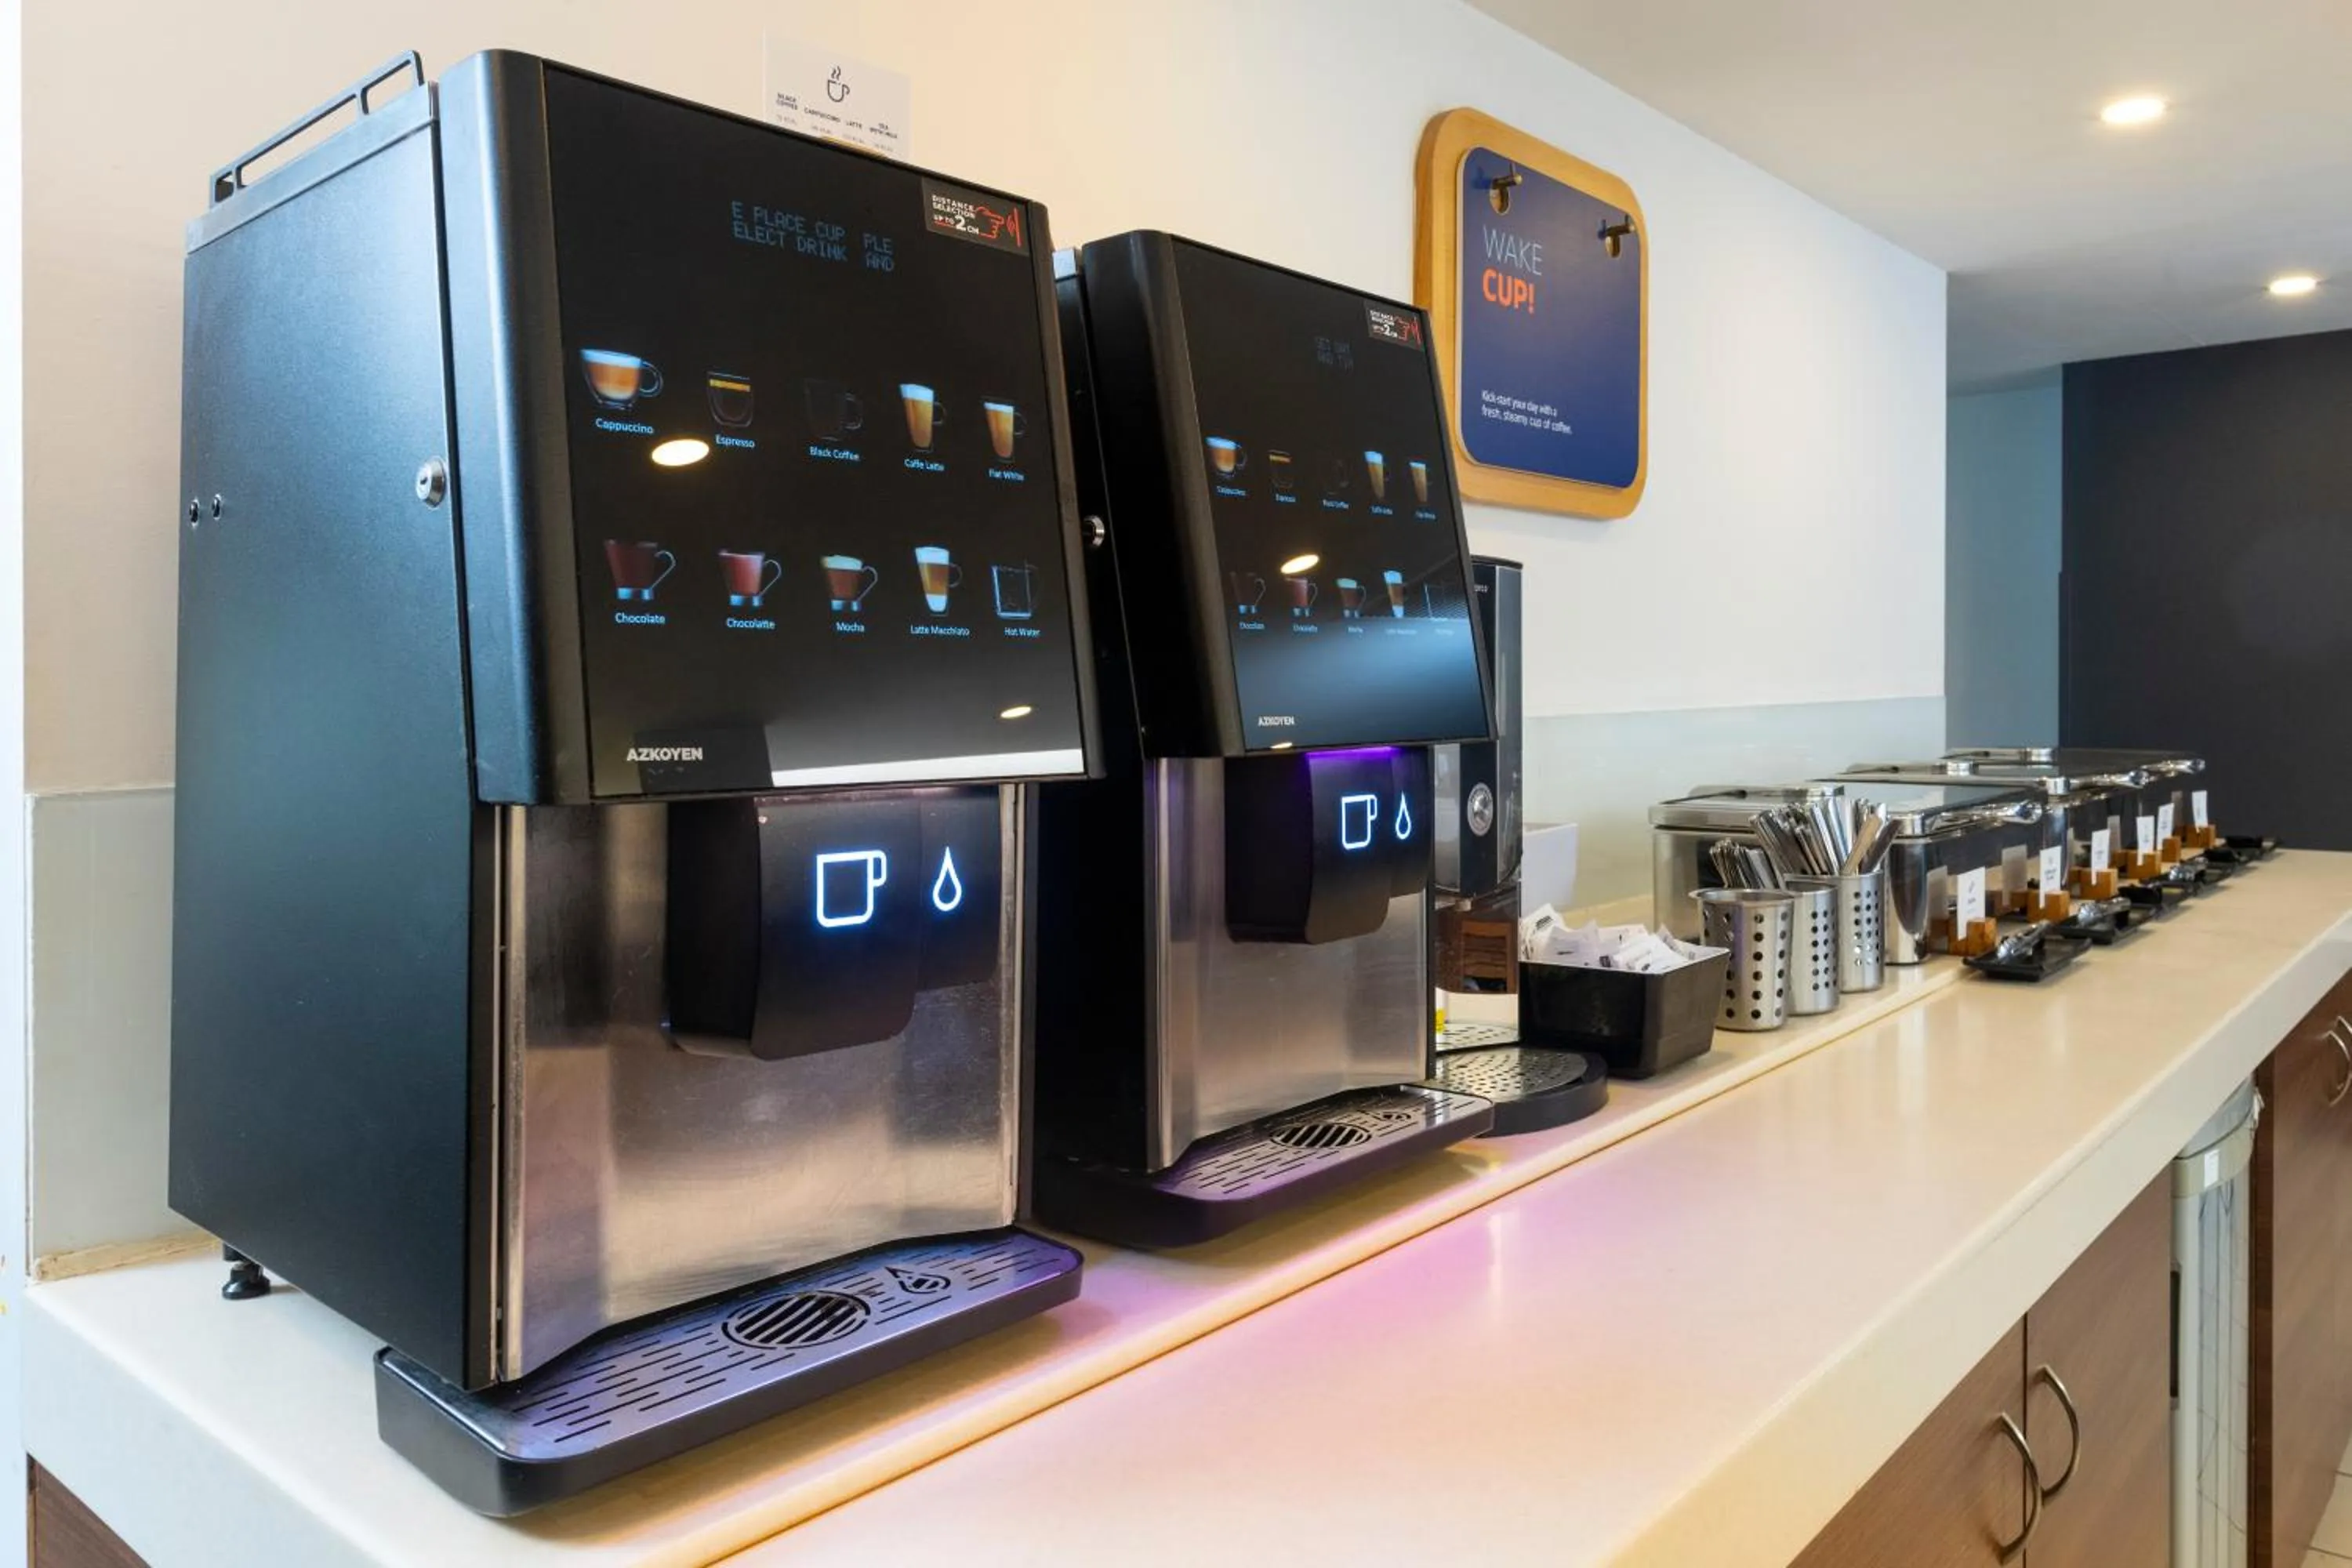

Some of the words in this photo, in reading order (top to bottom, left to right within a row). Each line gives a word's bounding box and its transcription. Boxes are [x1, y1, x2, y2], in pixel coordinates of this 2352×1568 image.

[932, 194, 975, 212] DISTANCE
[933, 201, 975, 220] SELECTION
[731, 201, 743, 220] E
[753, 206, 807, 234] PLACE
[815, 221, 846, 241] CUP
[863, 233, 892, 255] PLE
[955, 215, 967, 232] 2
[967, 225, 979, 234] CM
[732, 220, 786, 249] ELECT
[797, 236, 848, 261] DRINK
[866, 254, 895, 272] AND
[1483, 224, 1542, 275] WAKE
[1482, 267, 1535, 314] CUP!
[1526, 401, 1538, 415] day
[595, 417, 655, 434] Cappuccino
[1529, 416, 1542, 427] cup
[715, 433, 756, 448] Espresso
[810, 446, 832, 457] Black
[833, 449, 860, 461] Coffee
[925, 462, 945, 471] Latte
[1004, 470, 1025, 481] White
[615, 612, 666, 624] Chocolate
[836, 621, 866, 633] Mocha
[910, 624, 930, 635] Latte
[931, 625, 971, 637] Macchiato
[1004, 626, 1018, 637] Hot
[1018, 627, 1041, 638] Water
[626, 746, 703, 762] AZKOYEN
